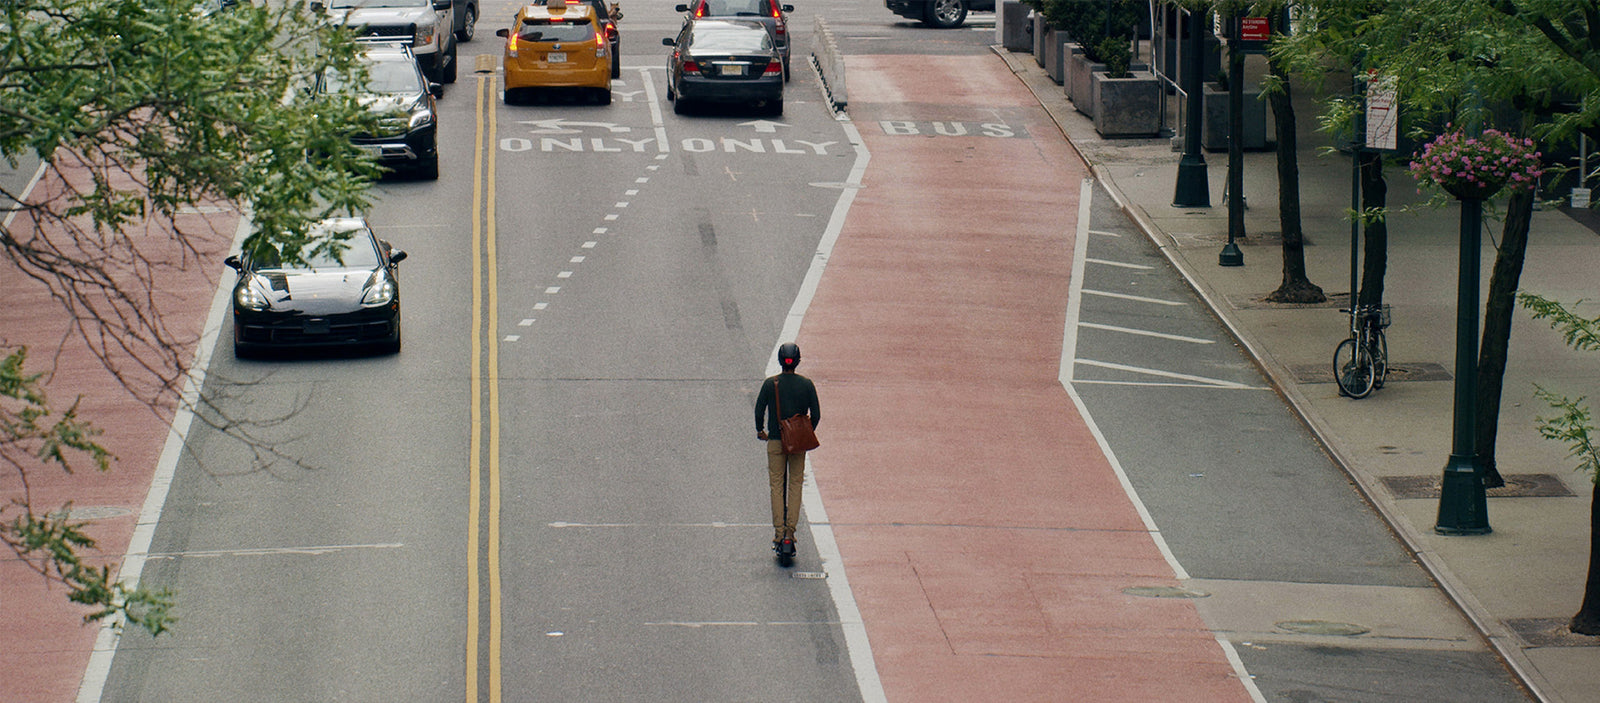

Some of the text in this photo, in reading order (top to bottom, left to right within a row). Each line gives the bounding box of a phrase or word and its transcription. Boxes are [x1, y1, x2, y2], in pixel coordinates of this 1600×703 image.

[879, 121, 1015, 138] BUS
[500, 137, 654, 152] ONLY
[681, 138, 839, 155] ONLY
